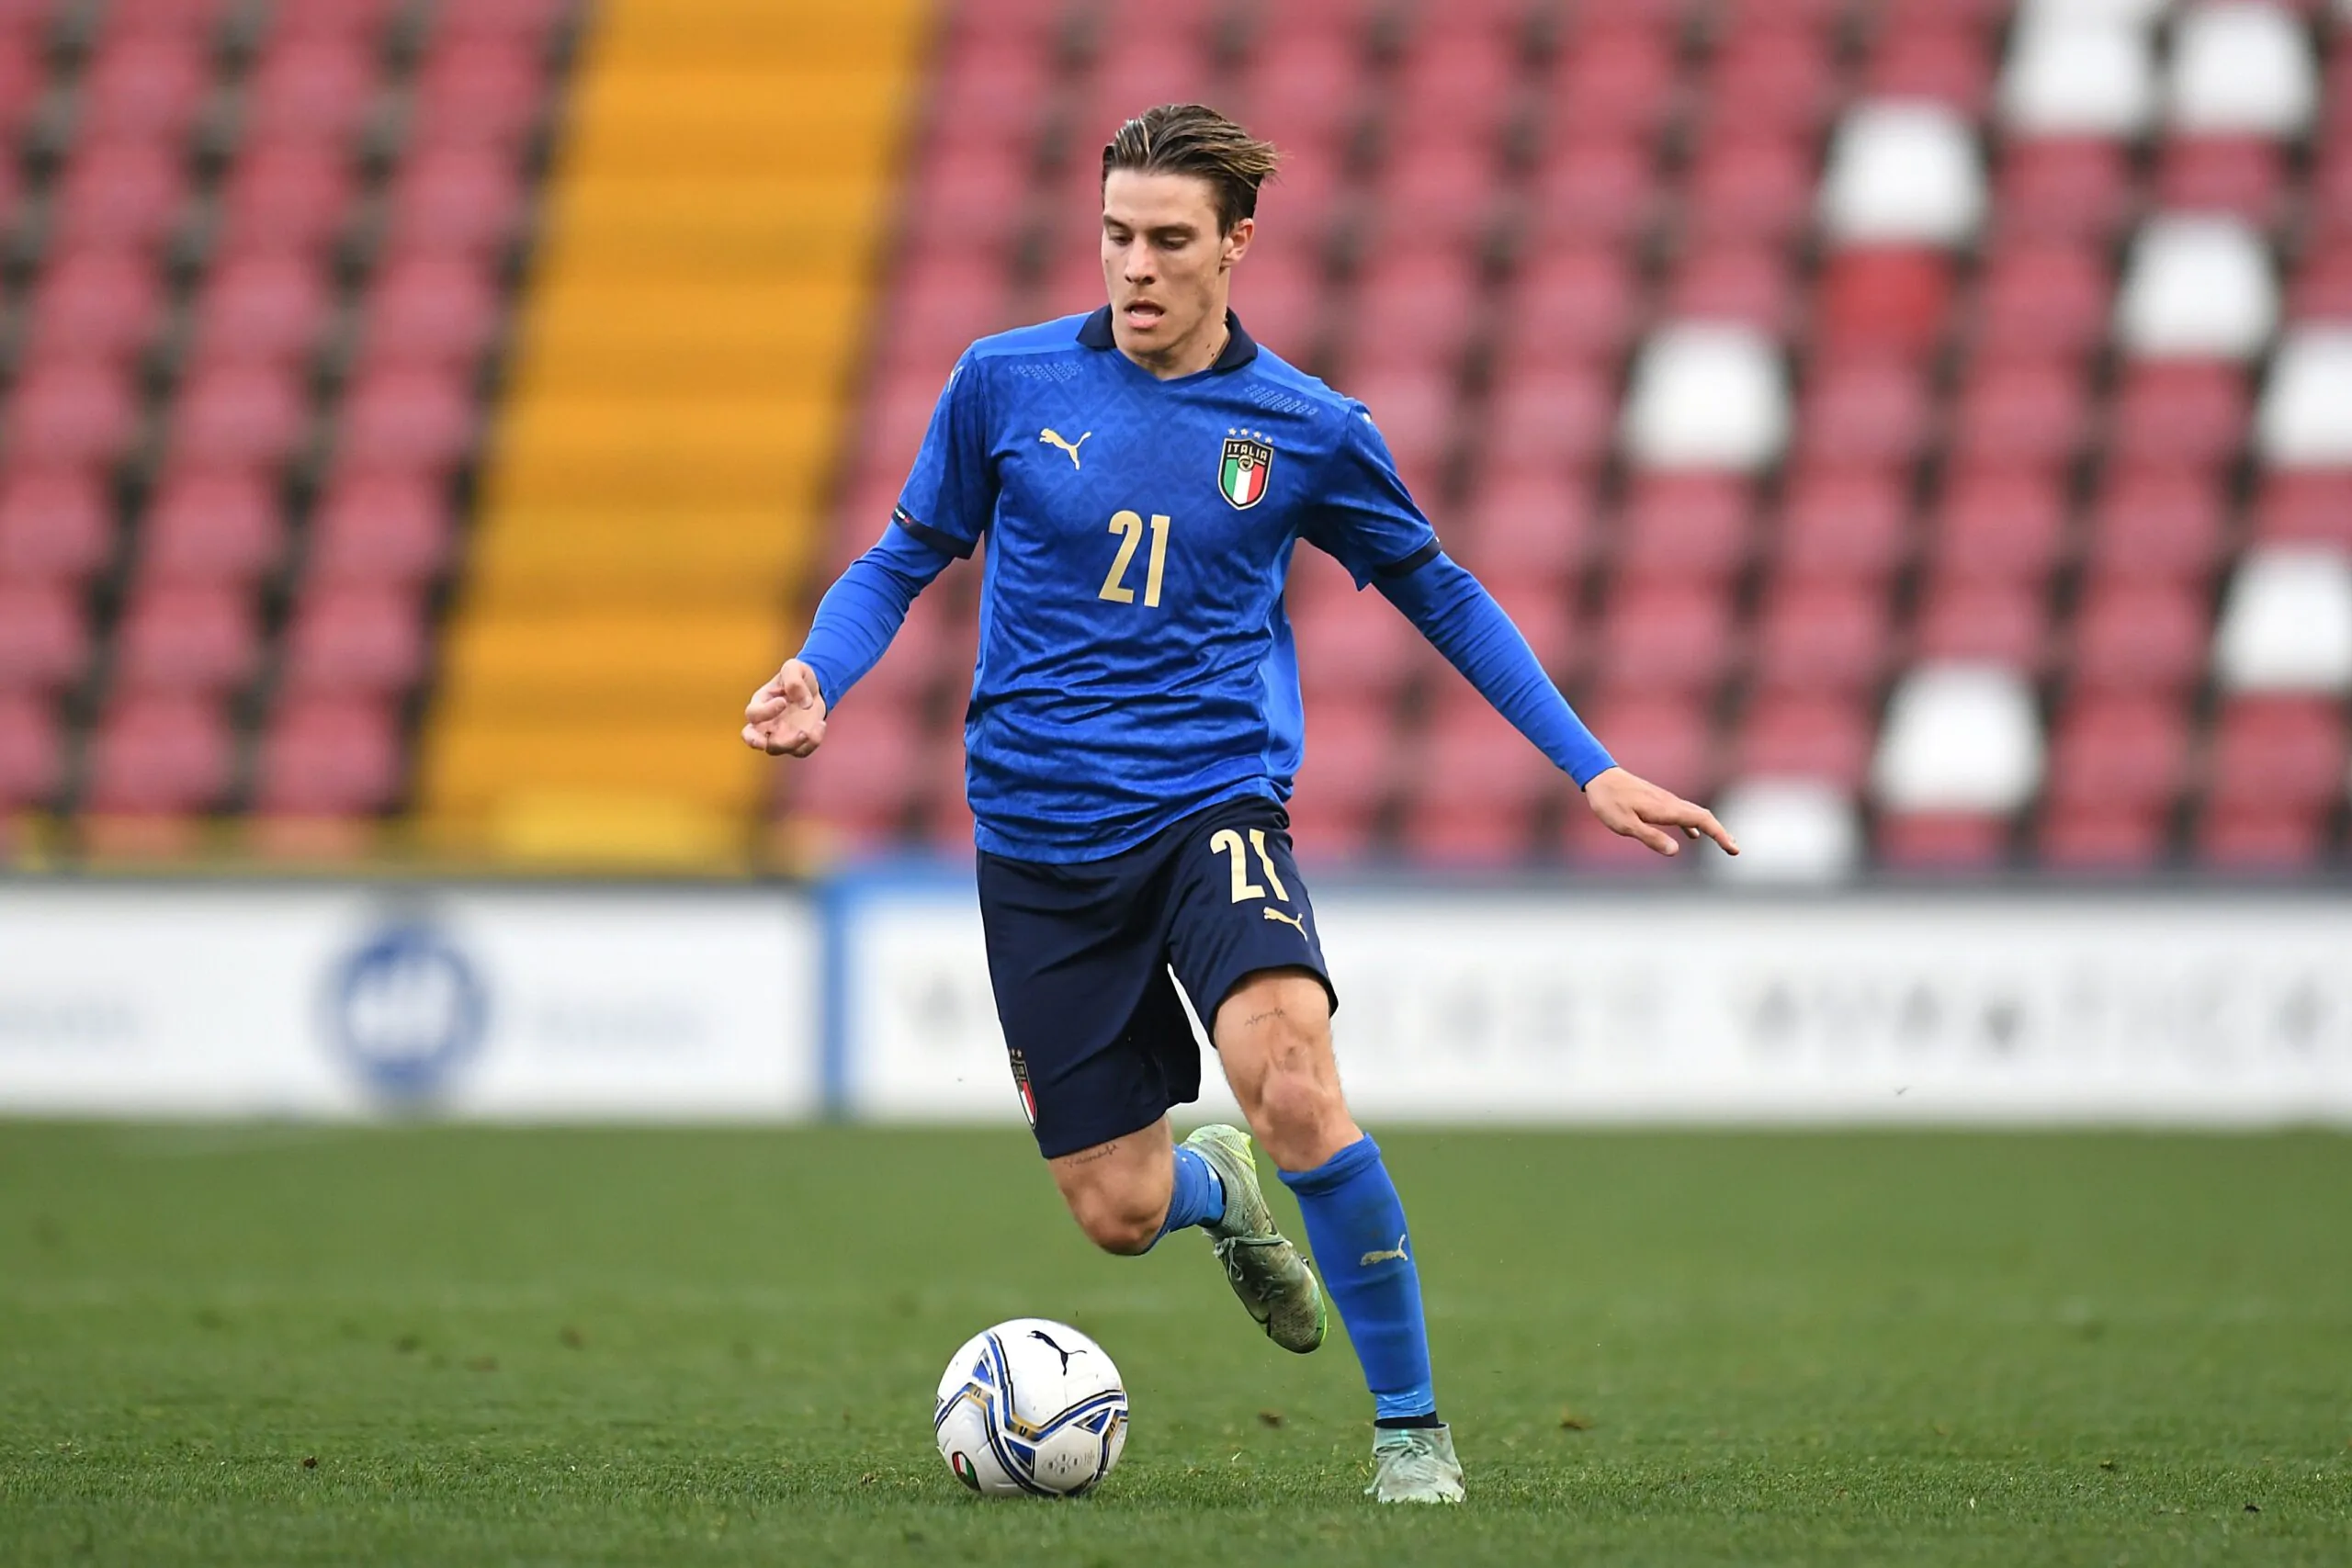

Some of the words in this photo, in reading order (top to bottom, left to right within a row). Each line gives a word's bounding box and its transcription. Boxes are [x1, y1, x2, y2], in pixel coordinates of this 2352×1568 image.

[1227, 444, 1267, 461] ITALIA
[1098, 510, 1170, 607] 21
[1210, 829, 1289, 904] 21
